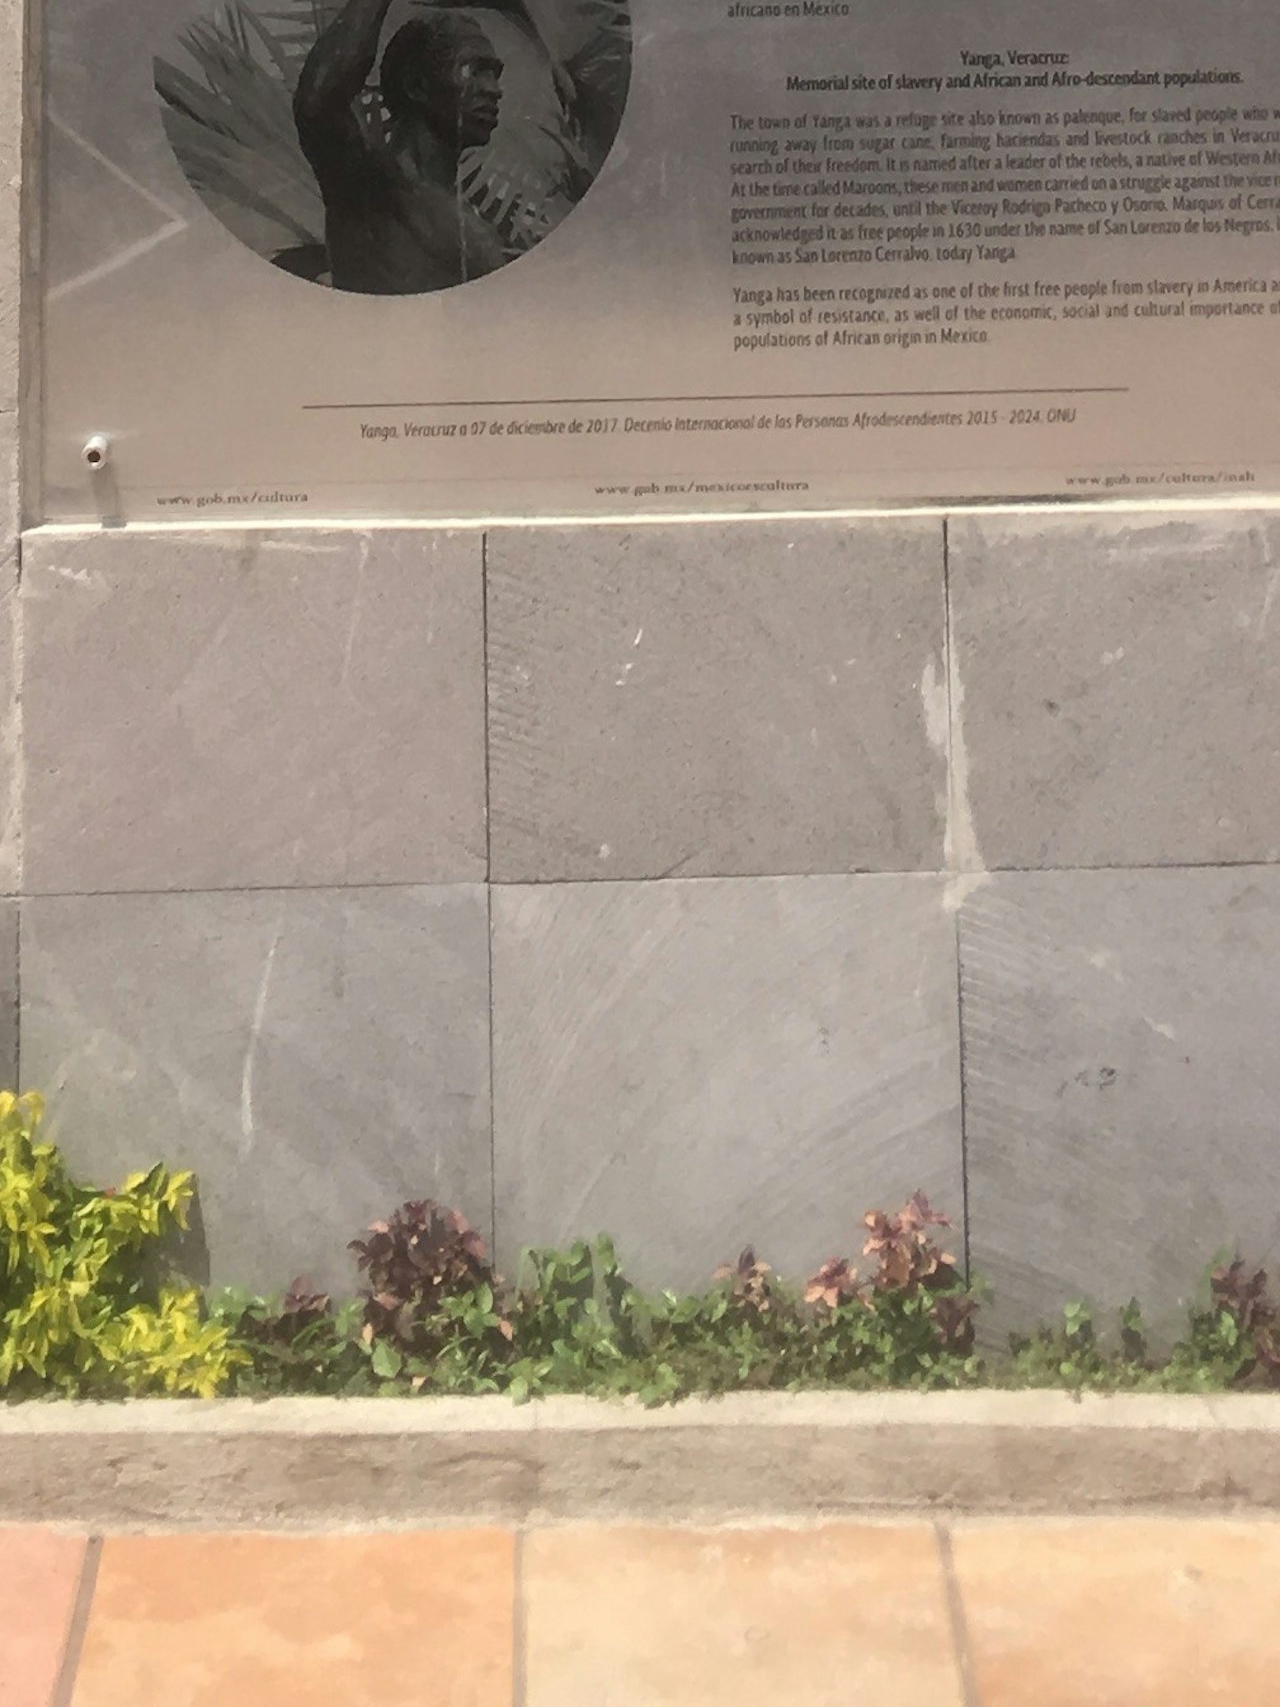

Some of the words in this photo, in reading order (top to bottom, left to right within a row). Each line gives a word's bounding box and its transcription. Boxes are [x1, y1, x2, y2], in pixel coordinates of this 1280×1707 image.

[786, 74, 849, 91] Memorial
[851, 73, 876, 90] site
[878, 73, 893, 90] of
[895, 72, 942, 93] slavery
[945, 72, 971, 89] and
[972, 71, 1021, 88] African
[1024, 70, 1048, 88] and
[1051, 69, 1160, 87] Afro-descendant
[1163, 67, 1243, 89] populations.
[732, 286, 773, 307] Yanga
[776, 285, 800, 302] has
[803, 285, 836, 301] been
[838, 284, 910, 305] recognized
[913, 286, 928, 299] as
[931, 285, 956, 299] one
[959, 281, 973, 299] of
[977, 282, 1000, 298] the
[1002, 280, 1030, 297] first
[1033, 279, 1060, 296] free
[1063, 280, 1107, 300] people
[1111, 278, 1143, 295] from
[1146, 278, 1193, 298] slavery
[1197, 281, 1209, 293] in
[1212, 276, 1267, 293] America
[733, 331, 811, 352] populations
[814, 329, 828, 346] of
[832, 328, 880, 346] African
[883, 331, 921, 349] origin
[924, 331, 937, 343] in
[403, 420, 457, 438] Veracruz
